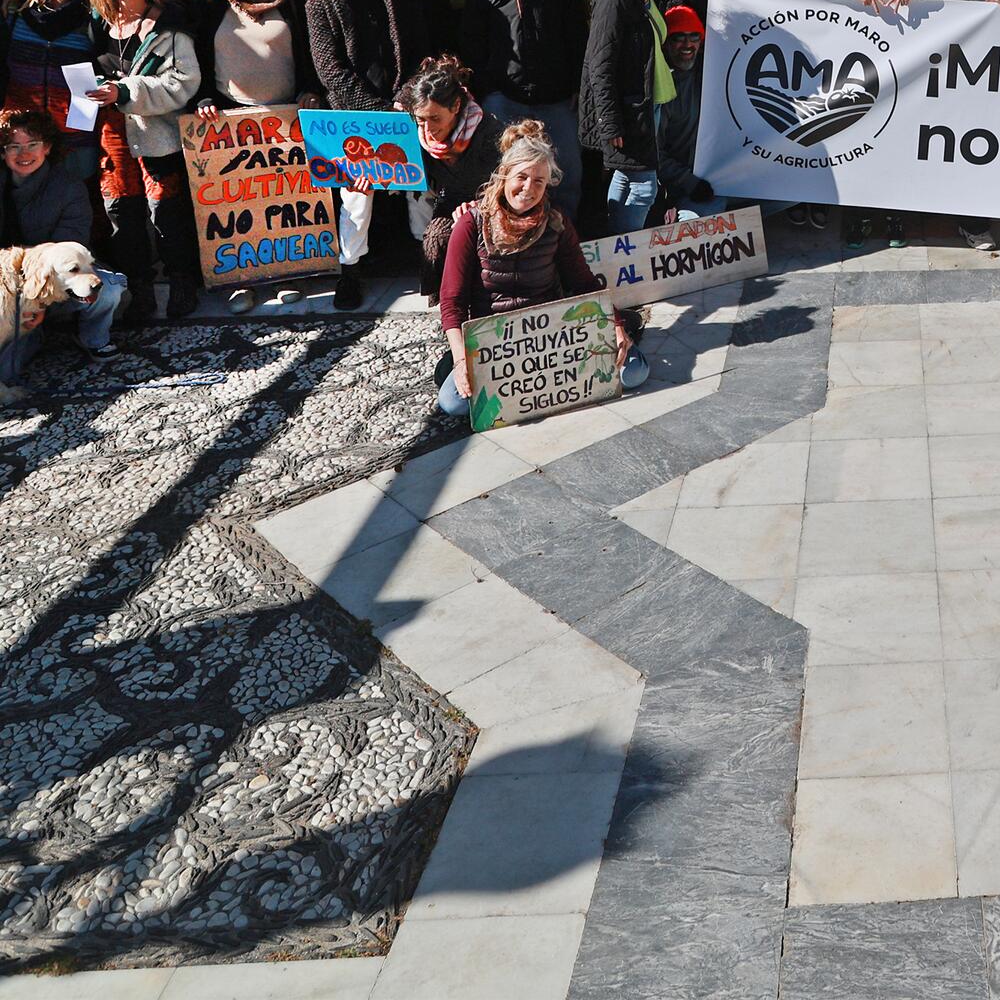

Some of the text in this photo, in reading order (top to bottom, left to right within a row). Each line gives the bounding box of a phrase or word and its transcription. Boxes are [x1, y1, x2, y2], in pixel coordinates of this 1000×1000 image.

[740, 9, 890, 53] ACCIÓN POR MARO
[745, 43, 880, 99] AMA
[309, 120, 410, 136] NO ES SUELO
[917, 124, 1000, 166] no
[219, 146, 306, 176] PARA
[742, 136, 874, 169] Y SU AGRICULTURA
[197, 167, 326, 205] CULTIVA
[206, 200, 330, 240] NO PARA
[214, 231, 336, 275] SAQUEAR
[614, 235, 636, 256] AL
[616, 264, 643, 287] AL
[478, 325, 589, 365] DESTRUYÁIS
[491, 347, 585, 381] LO QUE SE
[498, 367, 578, 397] CREÓ EN
